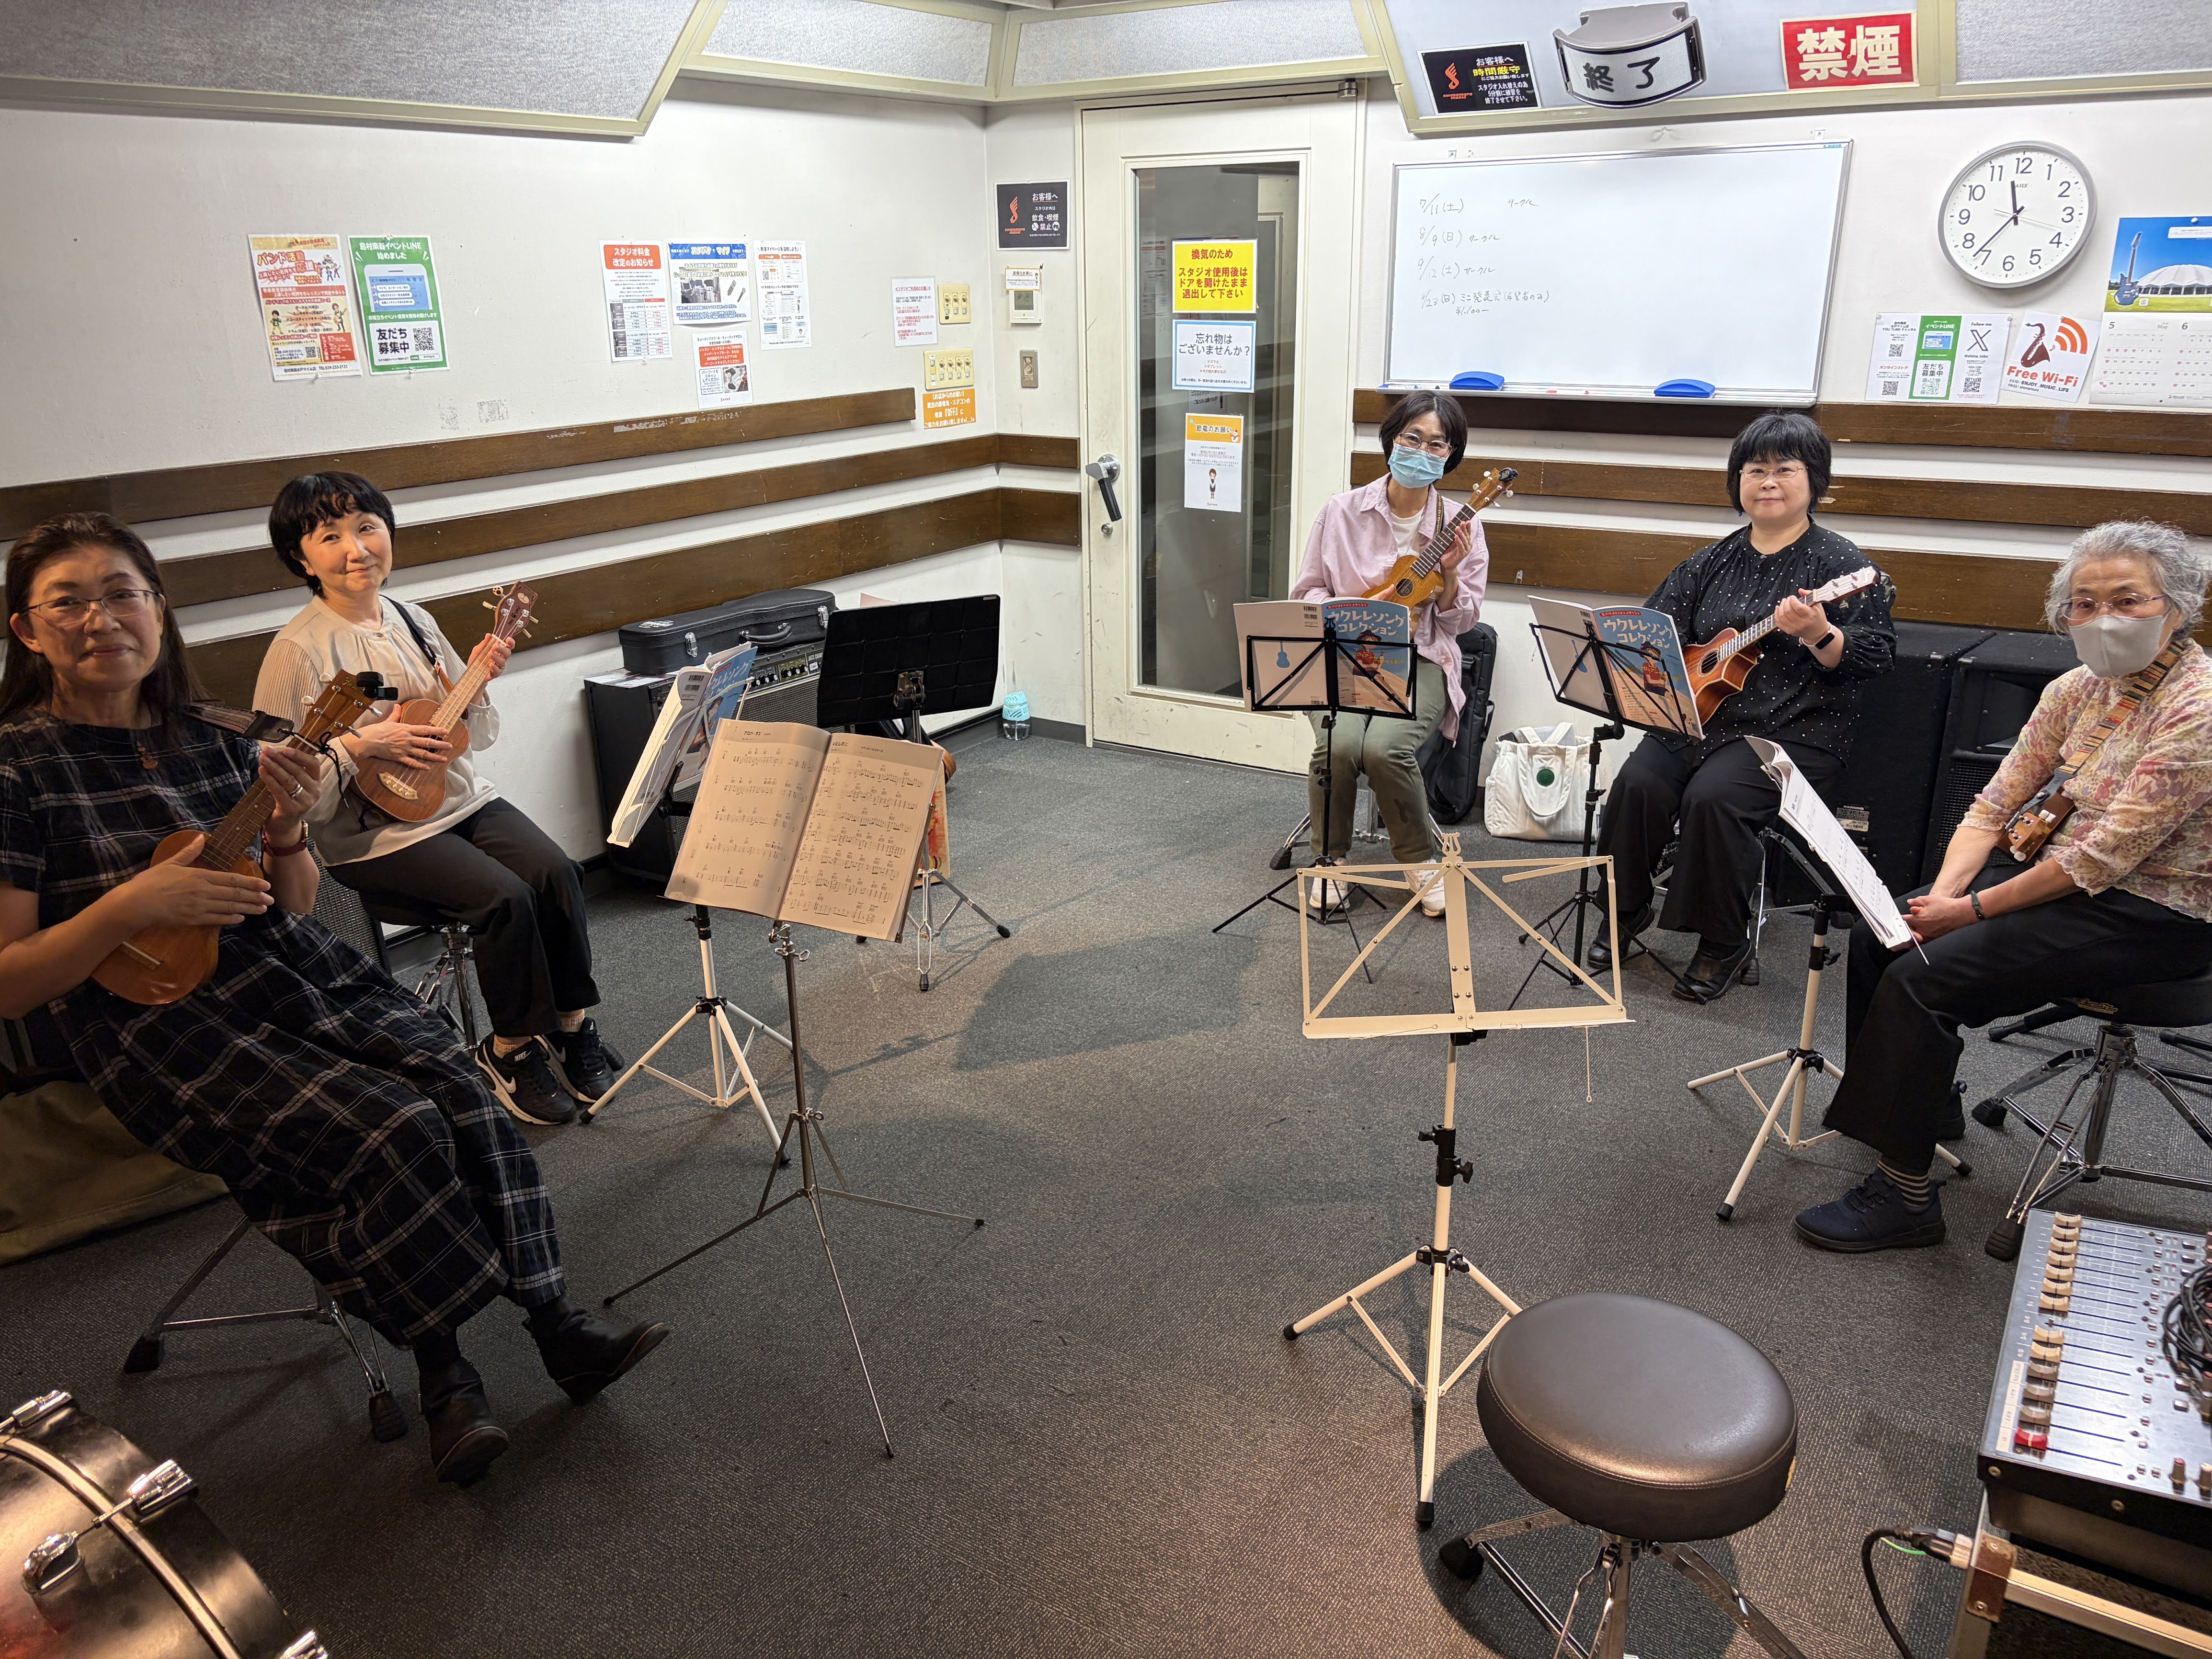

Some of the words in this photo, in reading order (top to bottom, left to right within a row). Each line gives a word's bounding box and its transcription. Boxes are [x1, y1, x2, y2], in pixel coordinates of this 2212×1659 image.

[1797, 25, 1902, 81] 禁煙
[1476, 56, 1514, 67] お客様へ
[1473, 66, 1521, 77] 時間厳守
[1583, 57, 1660, 92] 終了
[1478, 81, 1528, 91] スタジオ入れ替えの為
[2015, 157, 2032, 174] 12
[2047, 164, 2052, 181] 1
[1990, 165, 2003, 182] 11
[1032, 192, 1058, 201] お客様へ
[1968, 184, 1985, 201] 10
[2057, 181, 2071, 197] 2
[1032, 214, 1059, 222] 飲食・喫煙
[1958, 208, 1971, 225] 9
[2061, 206, 2075, 223] 3
[1962, 233, 1975, 249] 8
[2049, 232, 2063, 248] 4
[614, 247, 650, 256] スタジオ料金
[1191, 249, 1233, 260] 換気のため
[1980, 250, 1992, 265] 7
[2029, 249, 2041, 265] 5
[612, 258, 654, 267] 改定のお知らせ
[2002, 255, 2015, 271] 6
[1178, 267, 1248, 277] スタジオ使用後は
[1180, 278, 1247, 288] ドアを開けたまま
[1182, 289, 1243, 299] 退出して下さい
[376, 328, 407, 341] 友だち
[1196, 333, 1232, 344] 忘れ物は
[378, 341, 410, 354] 募集中
[1179, 343, 1250, 356] ございませんか？
[2007, 365, 2038, 380] Free
[2042, 371, 2079, 387] Wi-Fi
[1196, 424, 1232, 433] 節電のお願い
[1328, 610, 1406, 627] ウクレレソング
[1338, 622, 1397, 636] コレクション
[1603, 618, 1673, 639] ウクレレソング
[1617, 632, 1670, 649] コレクション
